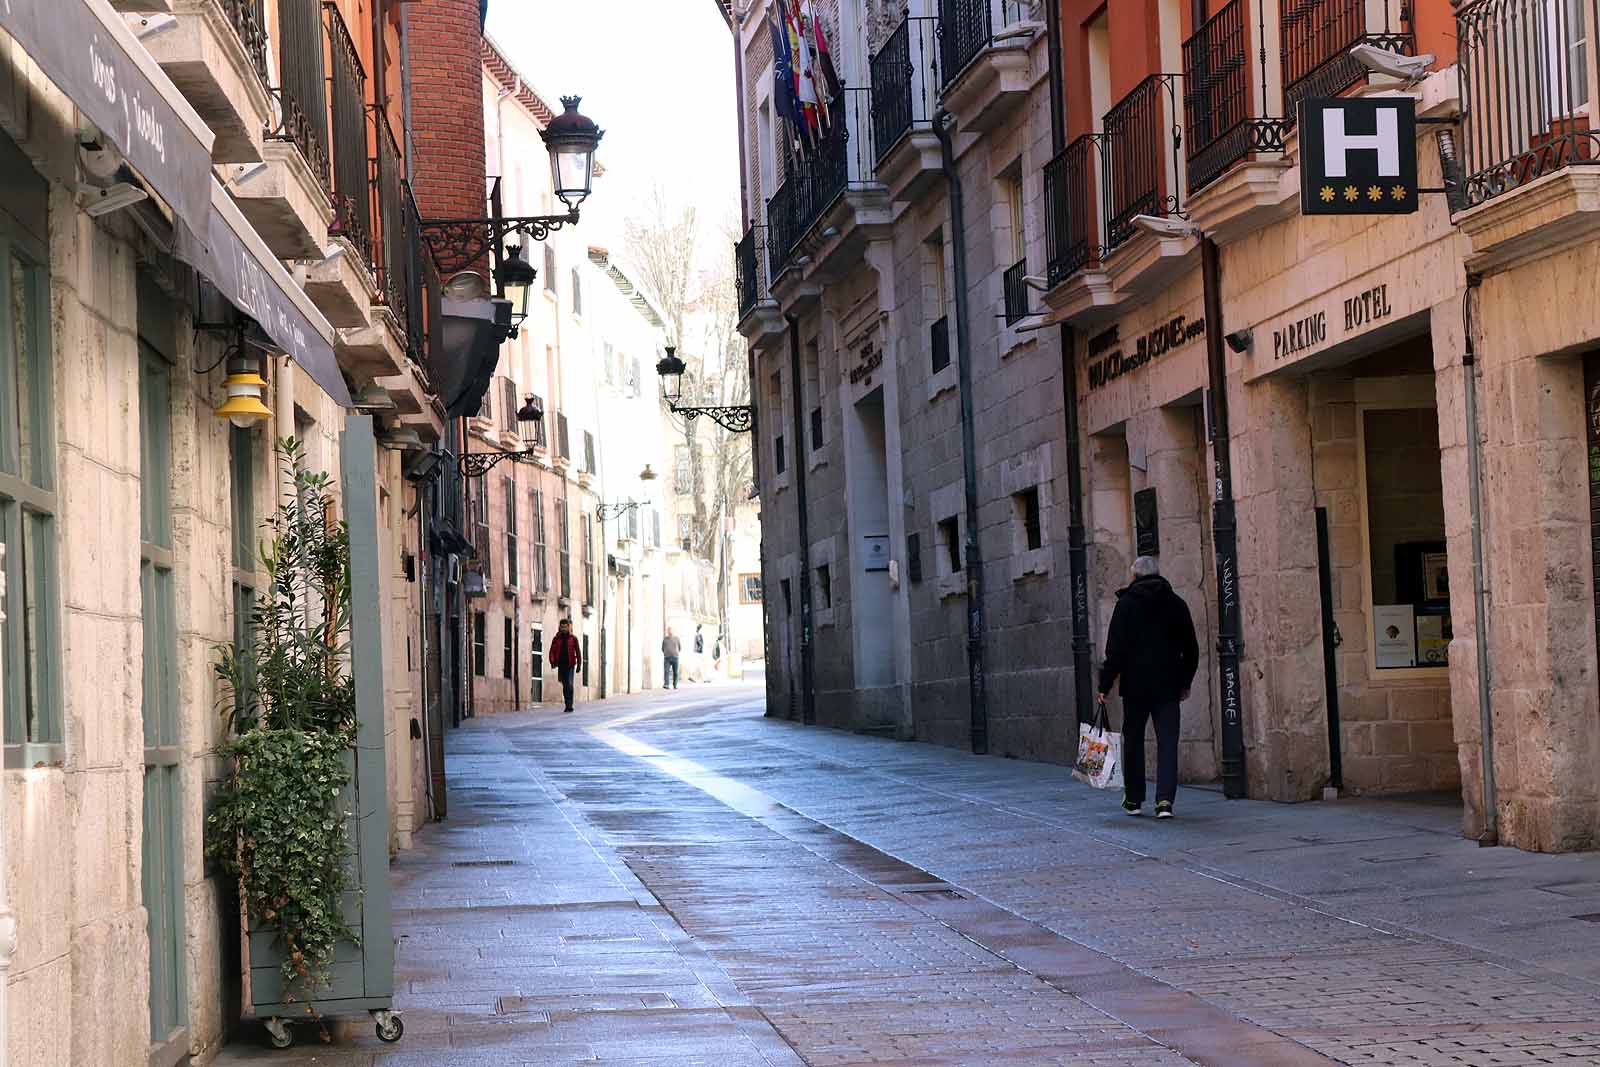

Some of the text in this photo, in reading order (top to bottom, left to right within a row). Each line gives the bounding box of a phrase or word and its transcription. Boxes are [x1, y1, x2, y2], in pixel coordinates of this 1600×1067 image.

[1323, 108, 1399, 177] H
[1273, 284, 1391, 360] PARKING HOTEL
